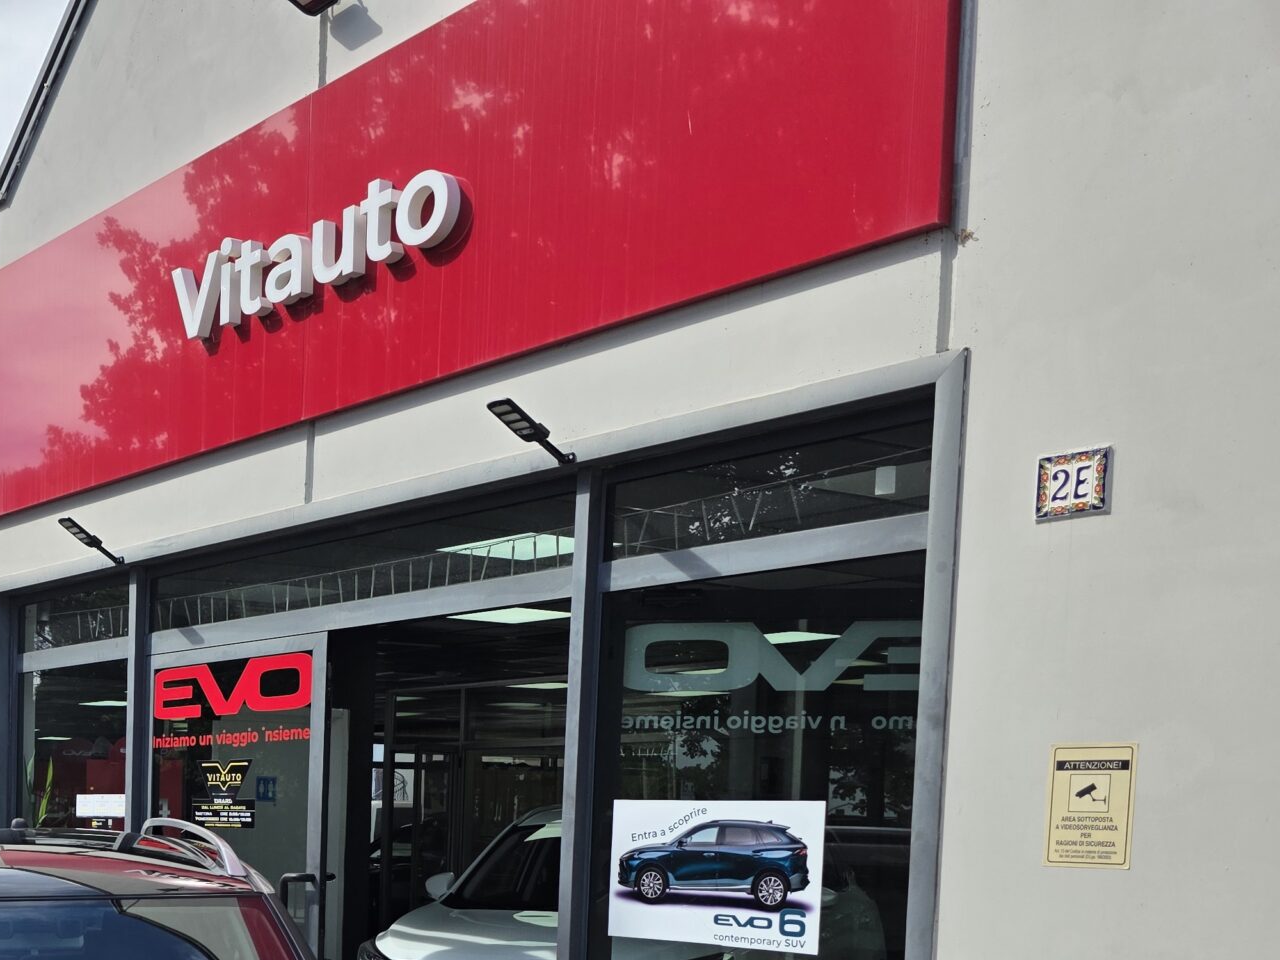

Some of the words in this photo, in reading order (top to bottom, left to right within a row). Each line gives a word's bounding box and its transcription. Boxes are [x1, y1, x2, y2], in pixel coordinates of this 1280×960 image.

[172, 169, 460, 340] Vitauto
[1051, 465, 1092, 502] 2E
[154, 653, 313, 720] EVO
[199, 735, 213, 747] un
[216, 728, 259, 748] viaggio
[261, 725, 311, 742] nsieme
[206, 773, 242, 782] VITAUTO
[1064, 761, 1122, 769] ATTENZIONE!
[631, 830, 658, 842] Entra
[668, 807, 708, 833] scoprire
[713, 914, 773, 929] EVO
[779, 908, 807, 937] 6
[713, 934, 782, 948] contemporary
[784, 938, 807, 948] SUV
